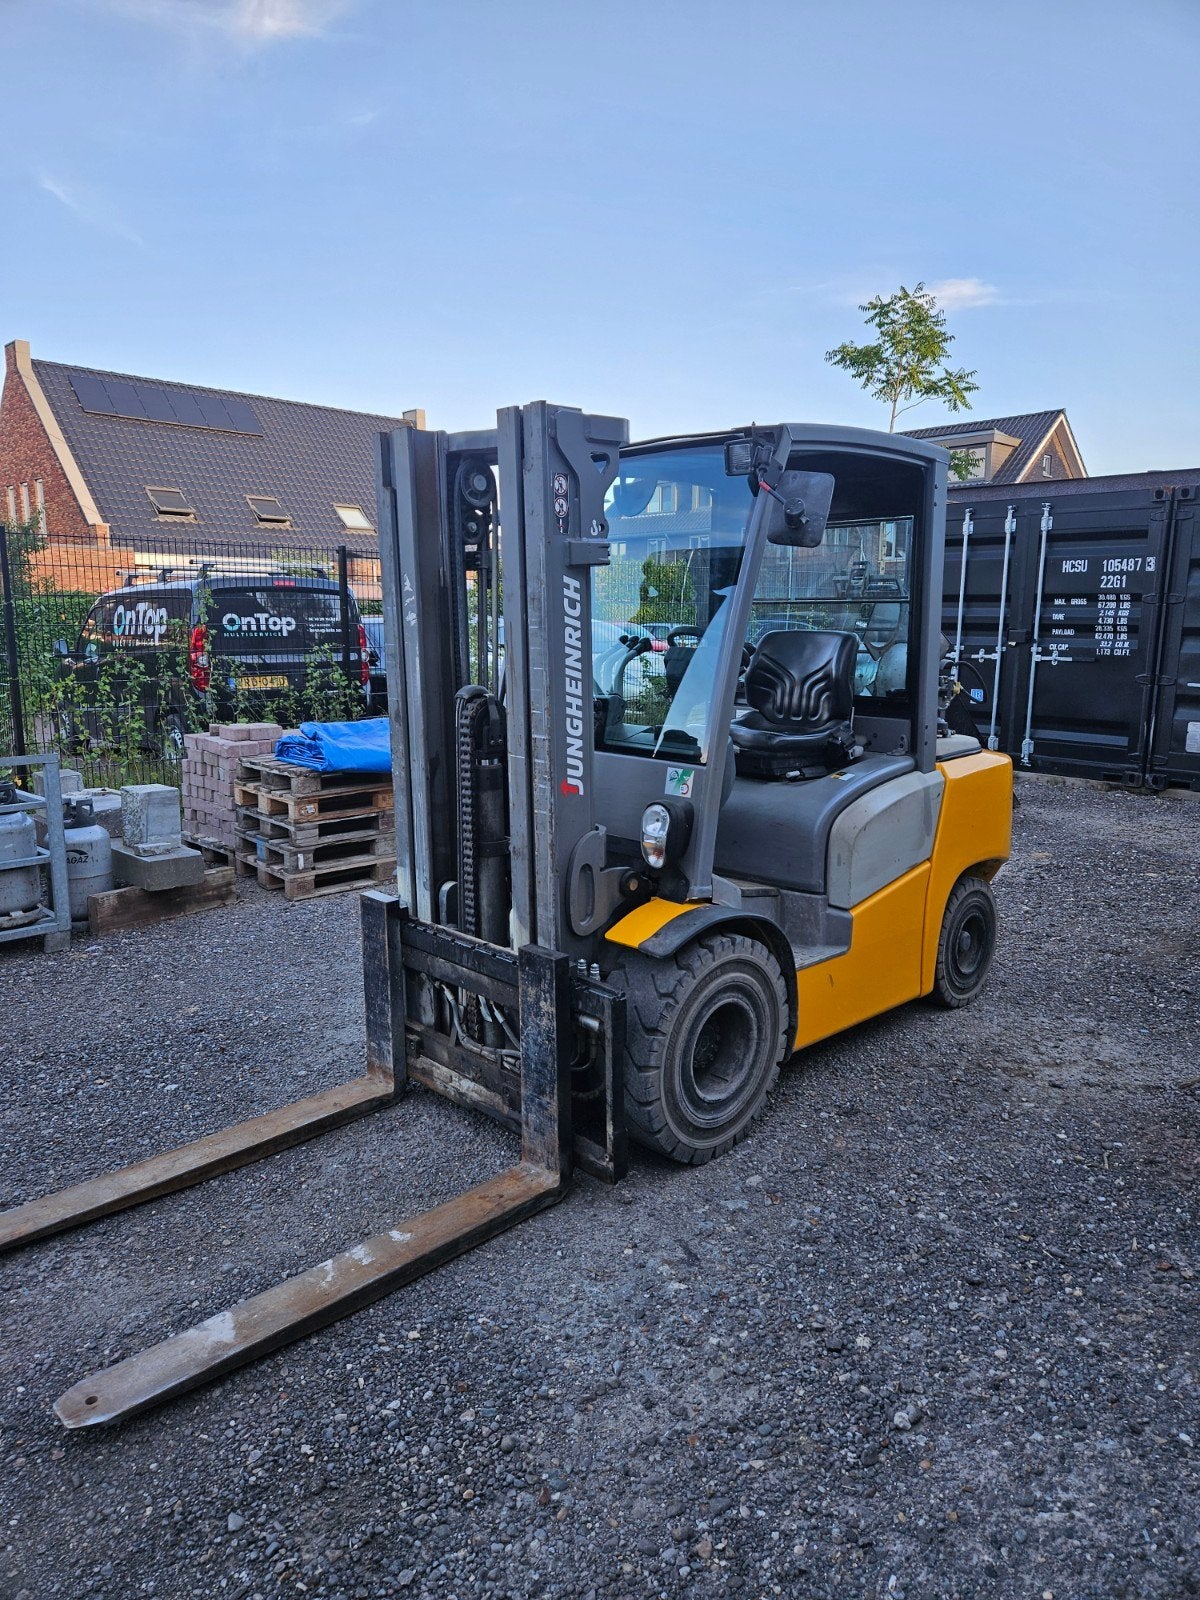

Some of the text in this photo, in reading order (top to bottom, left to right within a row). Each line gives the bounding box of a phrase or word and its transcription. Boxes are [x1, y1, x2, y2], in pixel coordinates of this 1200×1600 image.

[1062, 556, 1156, 573] HCSU 105487 3
[1100, 575, 1127, 588] 22G1
[113, 602, 168, 646] OnTop
[222, 613, 296, 637] OnTop
[1096, 648, 1111, 656] 1.173
[561, 575, 584, 797] JUNGHEINRICH
